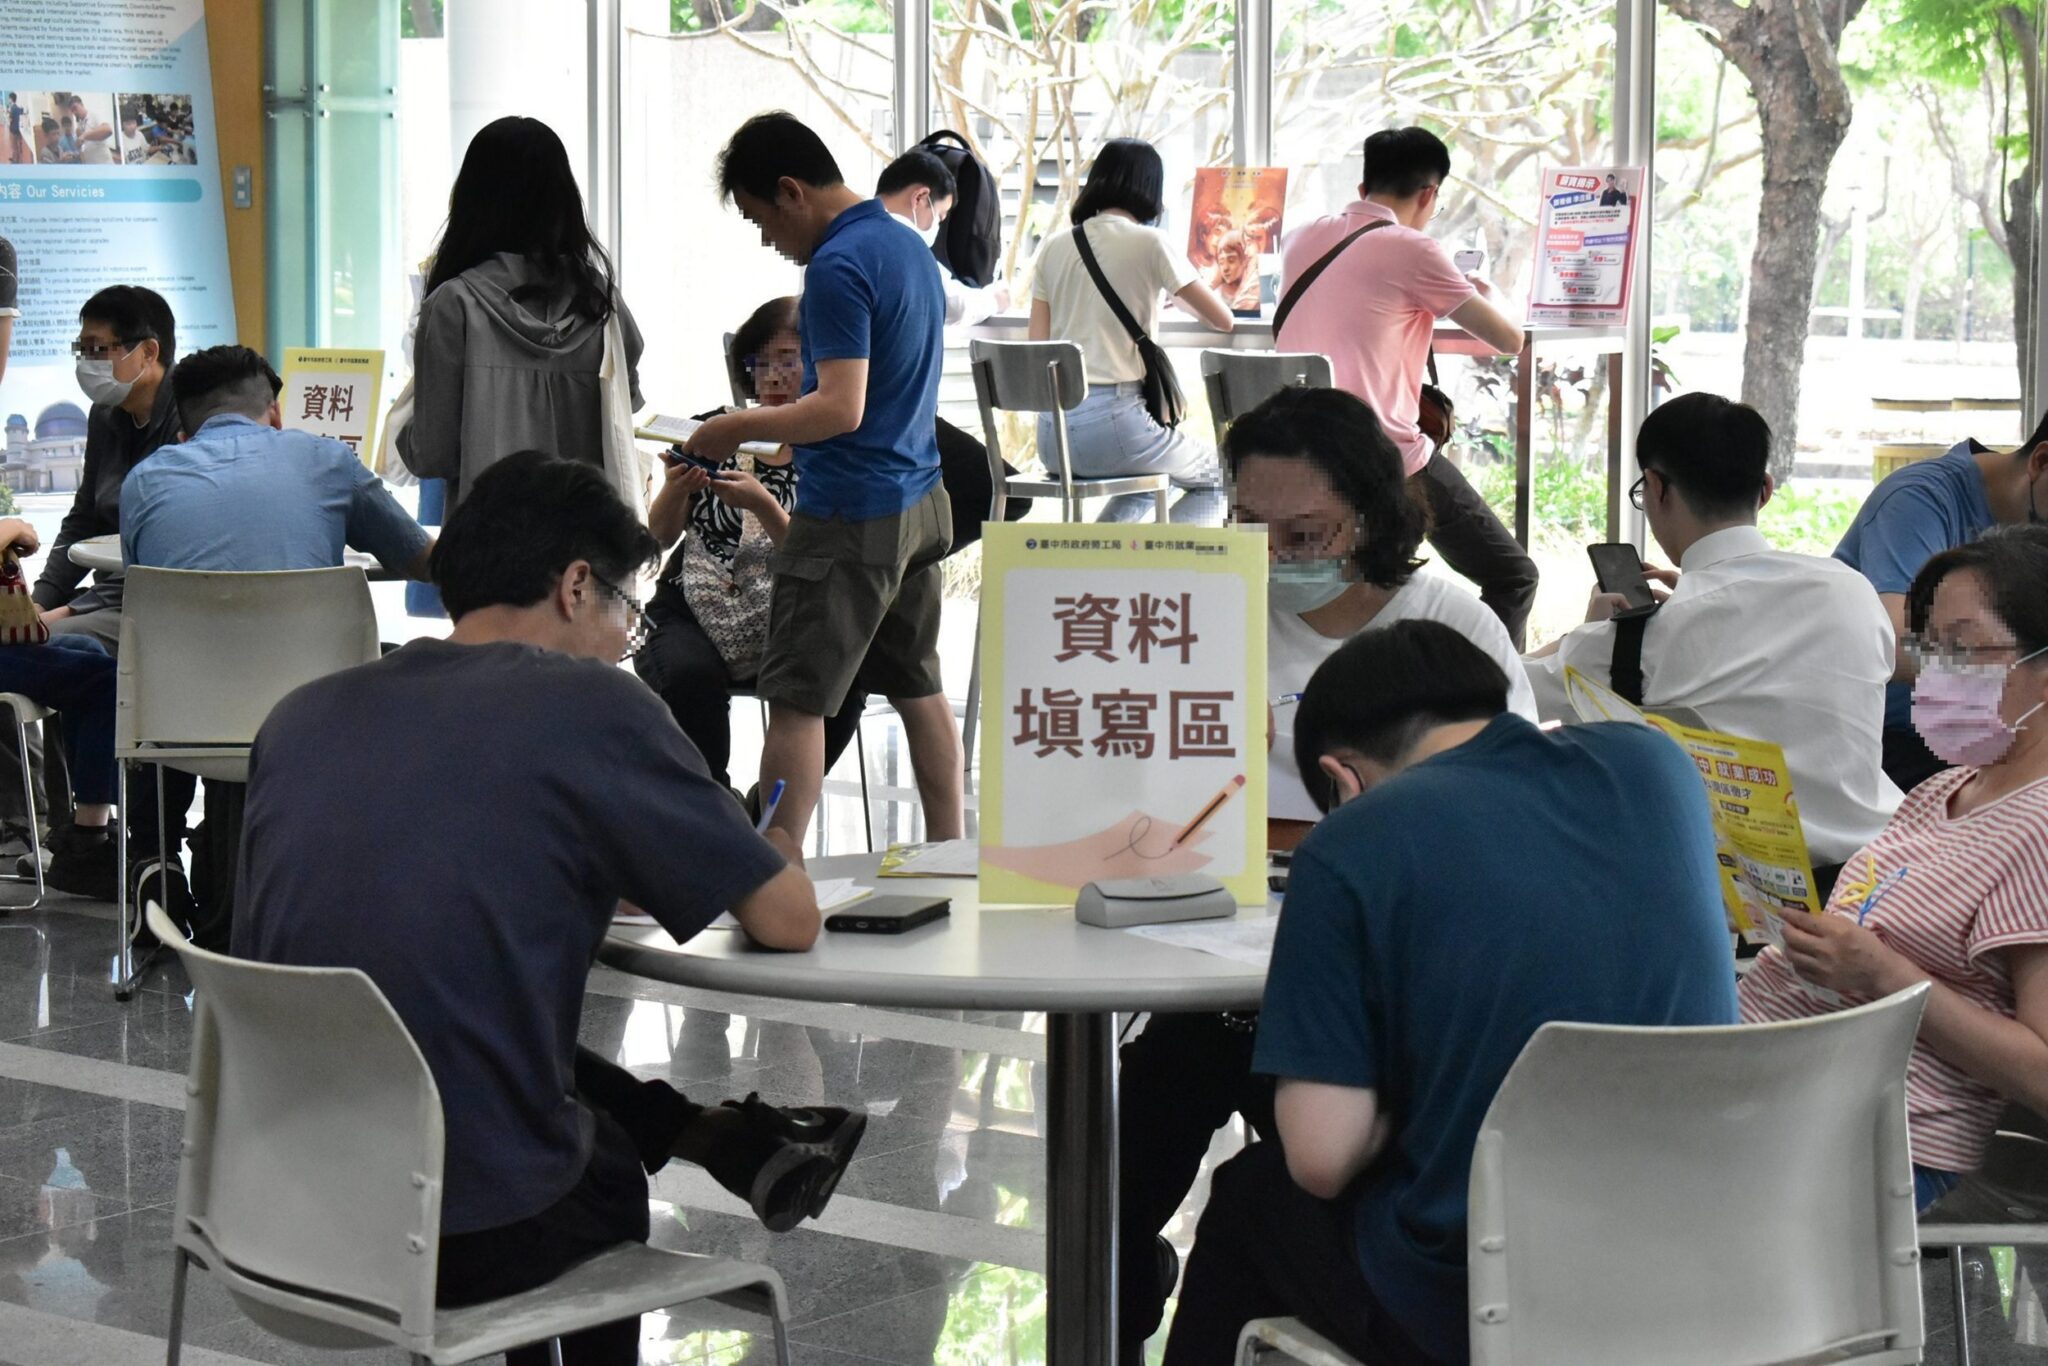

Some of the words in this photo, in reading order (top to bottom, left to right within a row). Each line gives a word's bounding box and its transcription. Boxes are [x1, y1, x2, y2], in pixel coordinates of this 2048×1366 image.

[26, 185, 46, 198] Our
[51, 184, 104, 198] Servicies
[302, 384, 354, 422] 資料
[1040, 540, 1122, 550] 臺中市政府勞工局
[1144, 540, 1226, 552] 臺中市就業
[1052, 592, 1198, 664] 資料
[1717, 762, 1776, 785] 就業成功
